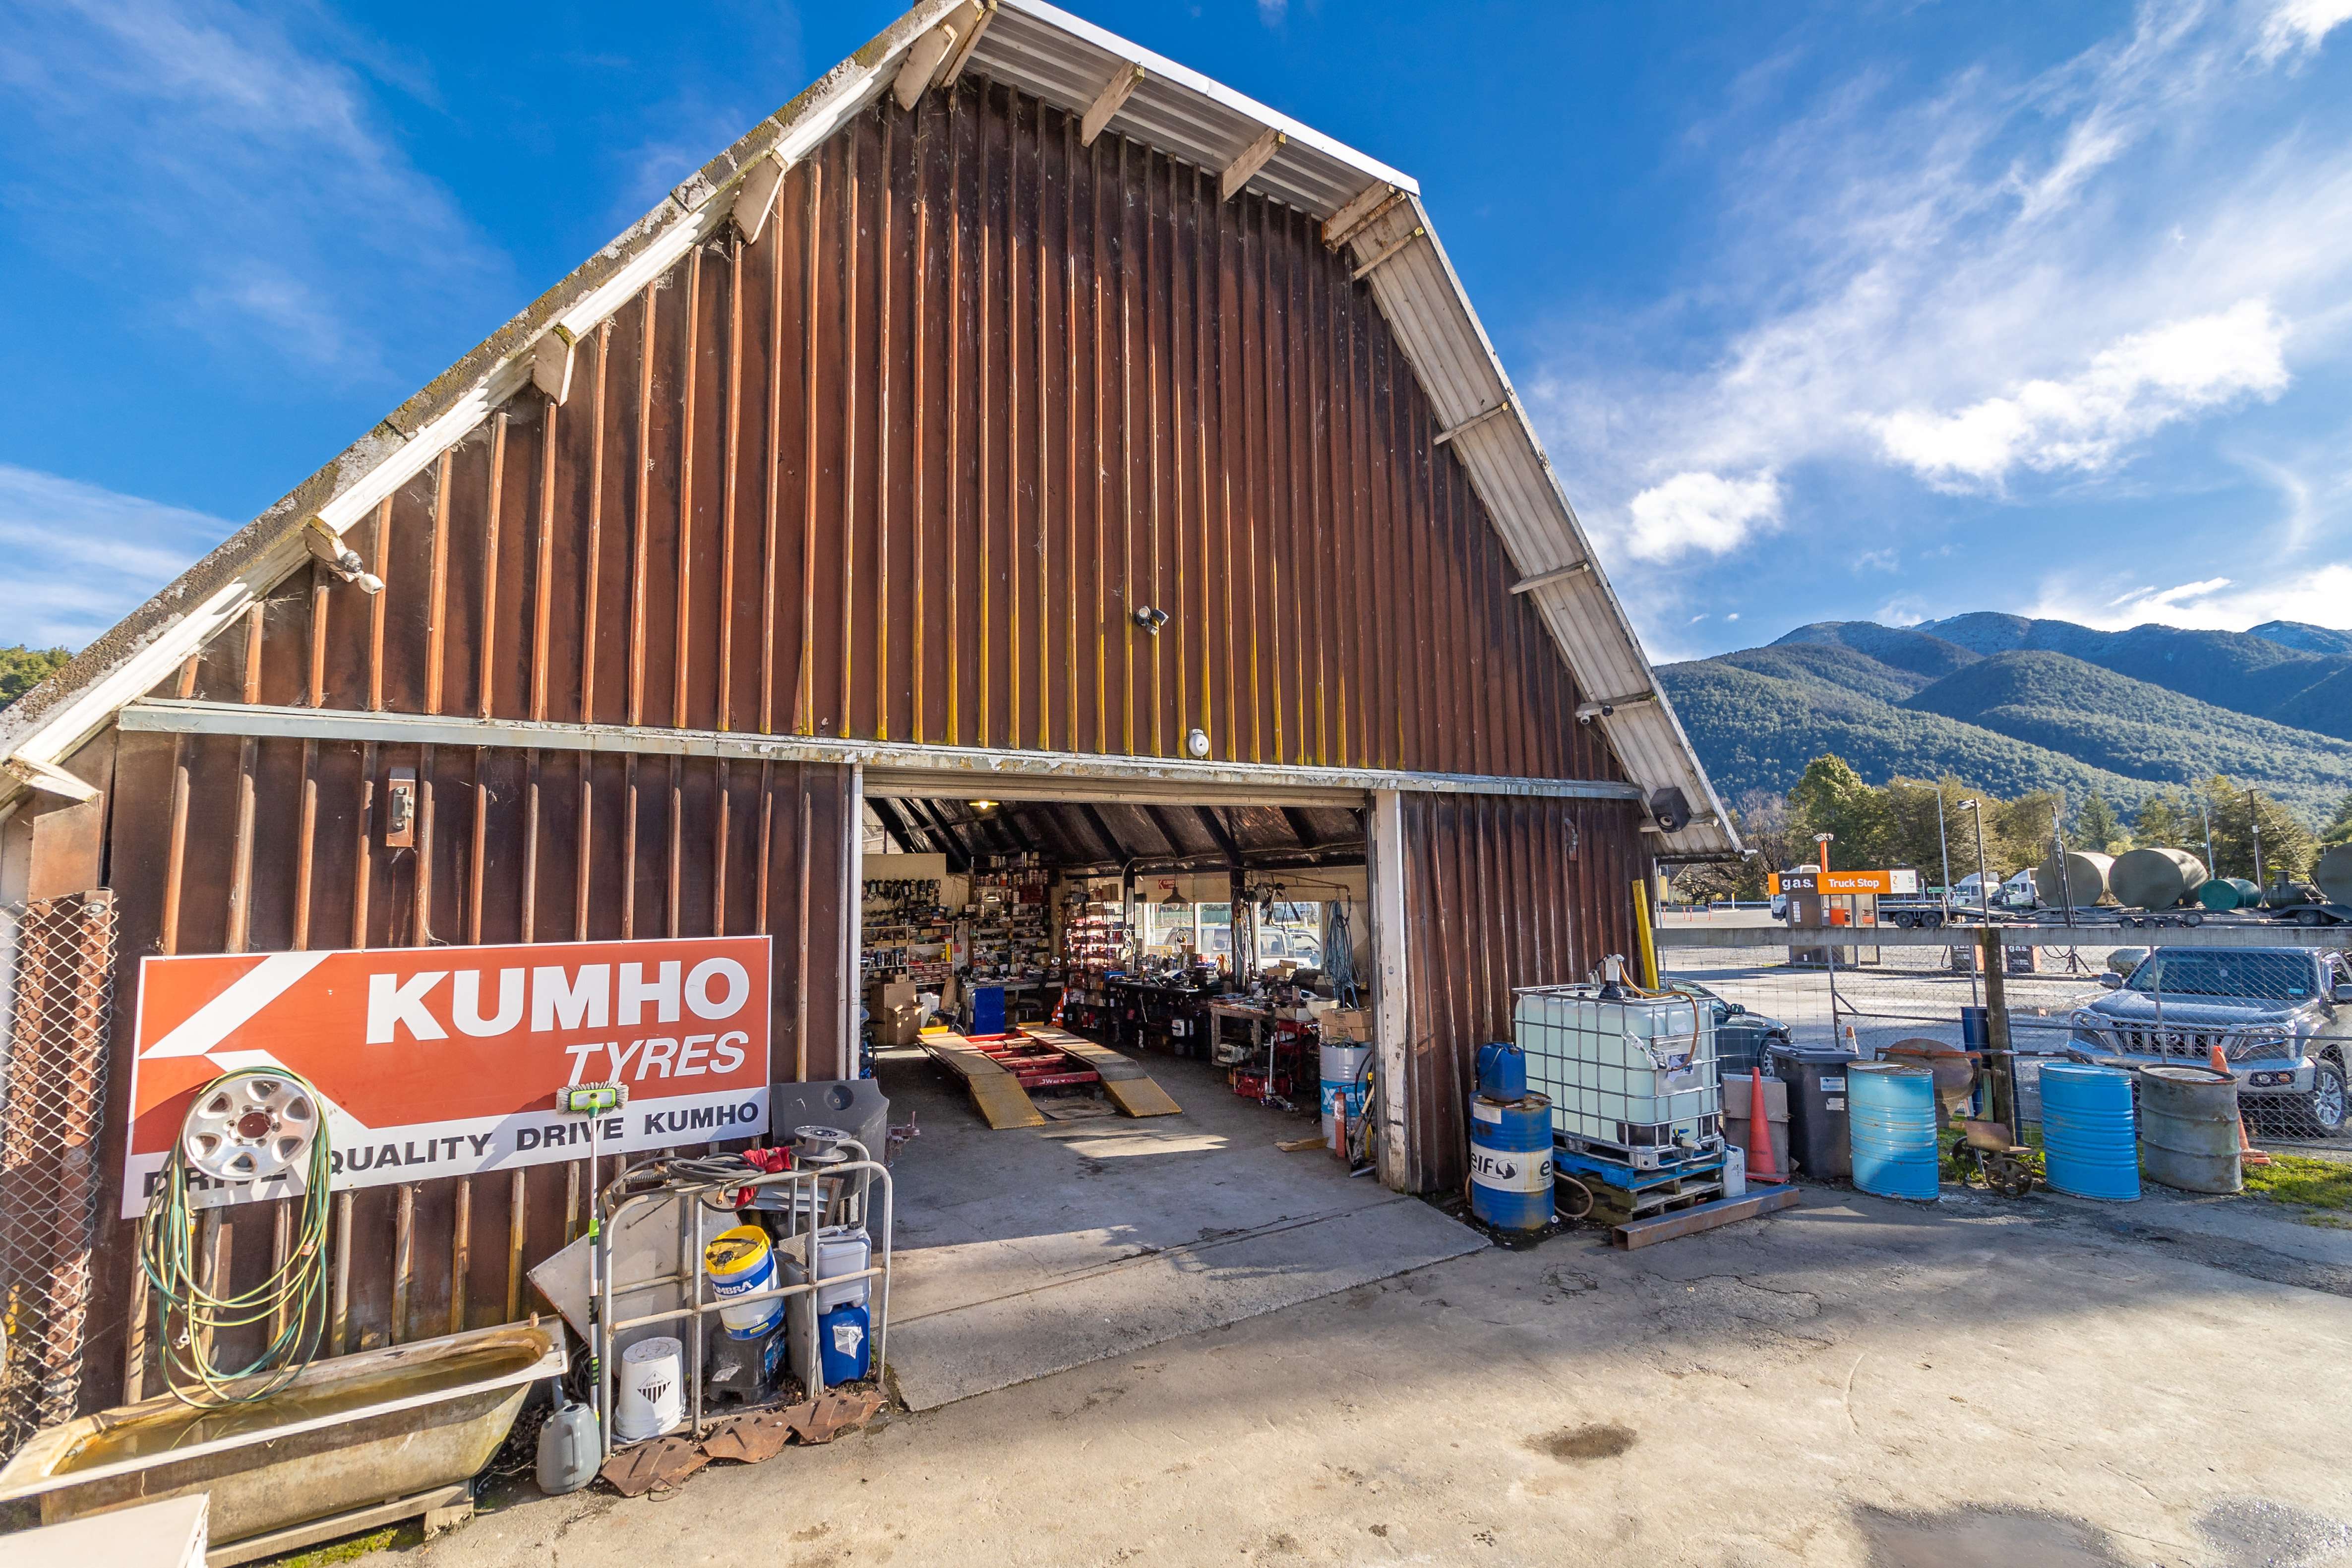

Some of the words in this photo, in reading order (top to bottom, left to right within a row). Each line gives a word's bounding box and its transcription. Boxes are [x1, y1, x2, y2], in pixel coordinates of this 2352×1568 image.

[1828, 878, 1855, 888] Truck
[1858, 878, 1879, 888] Stop
[366, 957, 750, 1044] KUMHO
[564, 1030, 750, 1086] TYRES
[1322, 1086, 1366, 1106] Xert
[330, 1133, 494, 1175] QUALITY
[516, 1117, 624, 1151] DRIVE
[645, 1102, 758, 1135] KUMHO
[1471, 1152, 1494, 1174] elf
[713, 1281, 754, 1294] AMBRA
